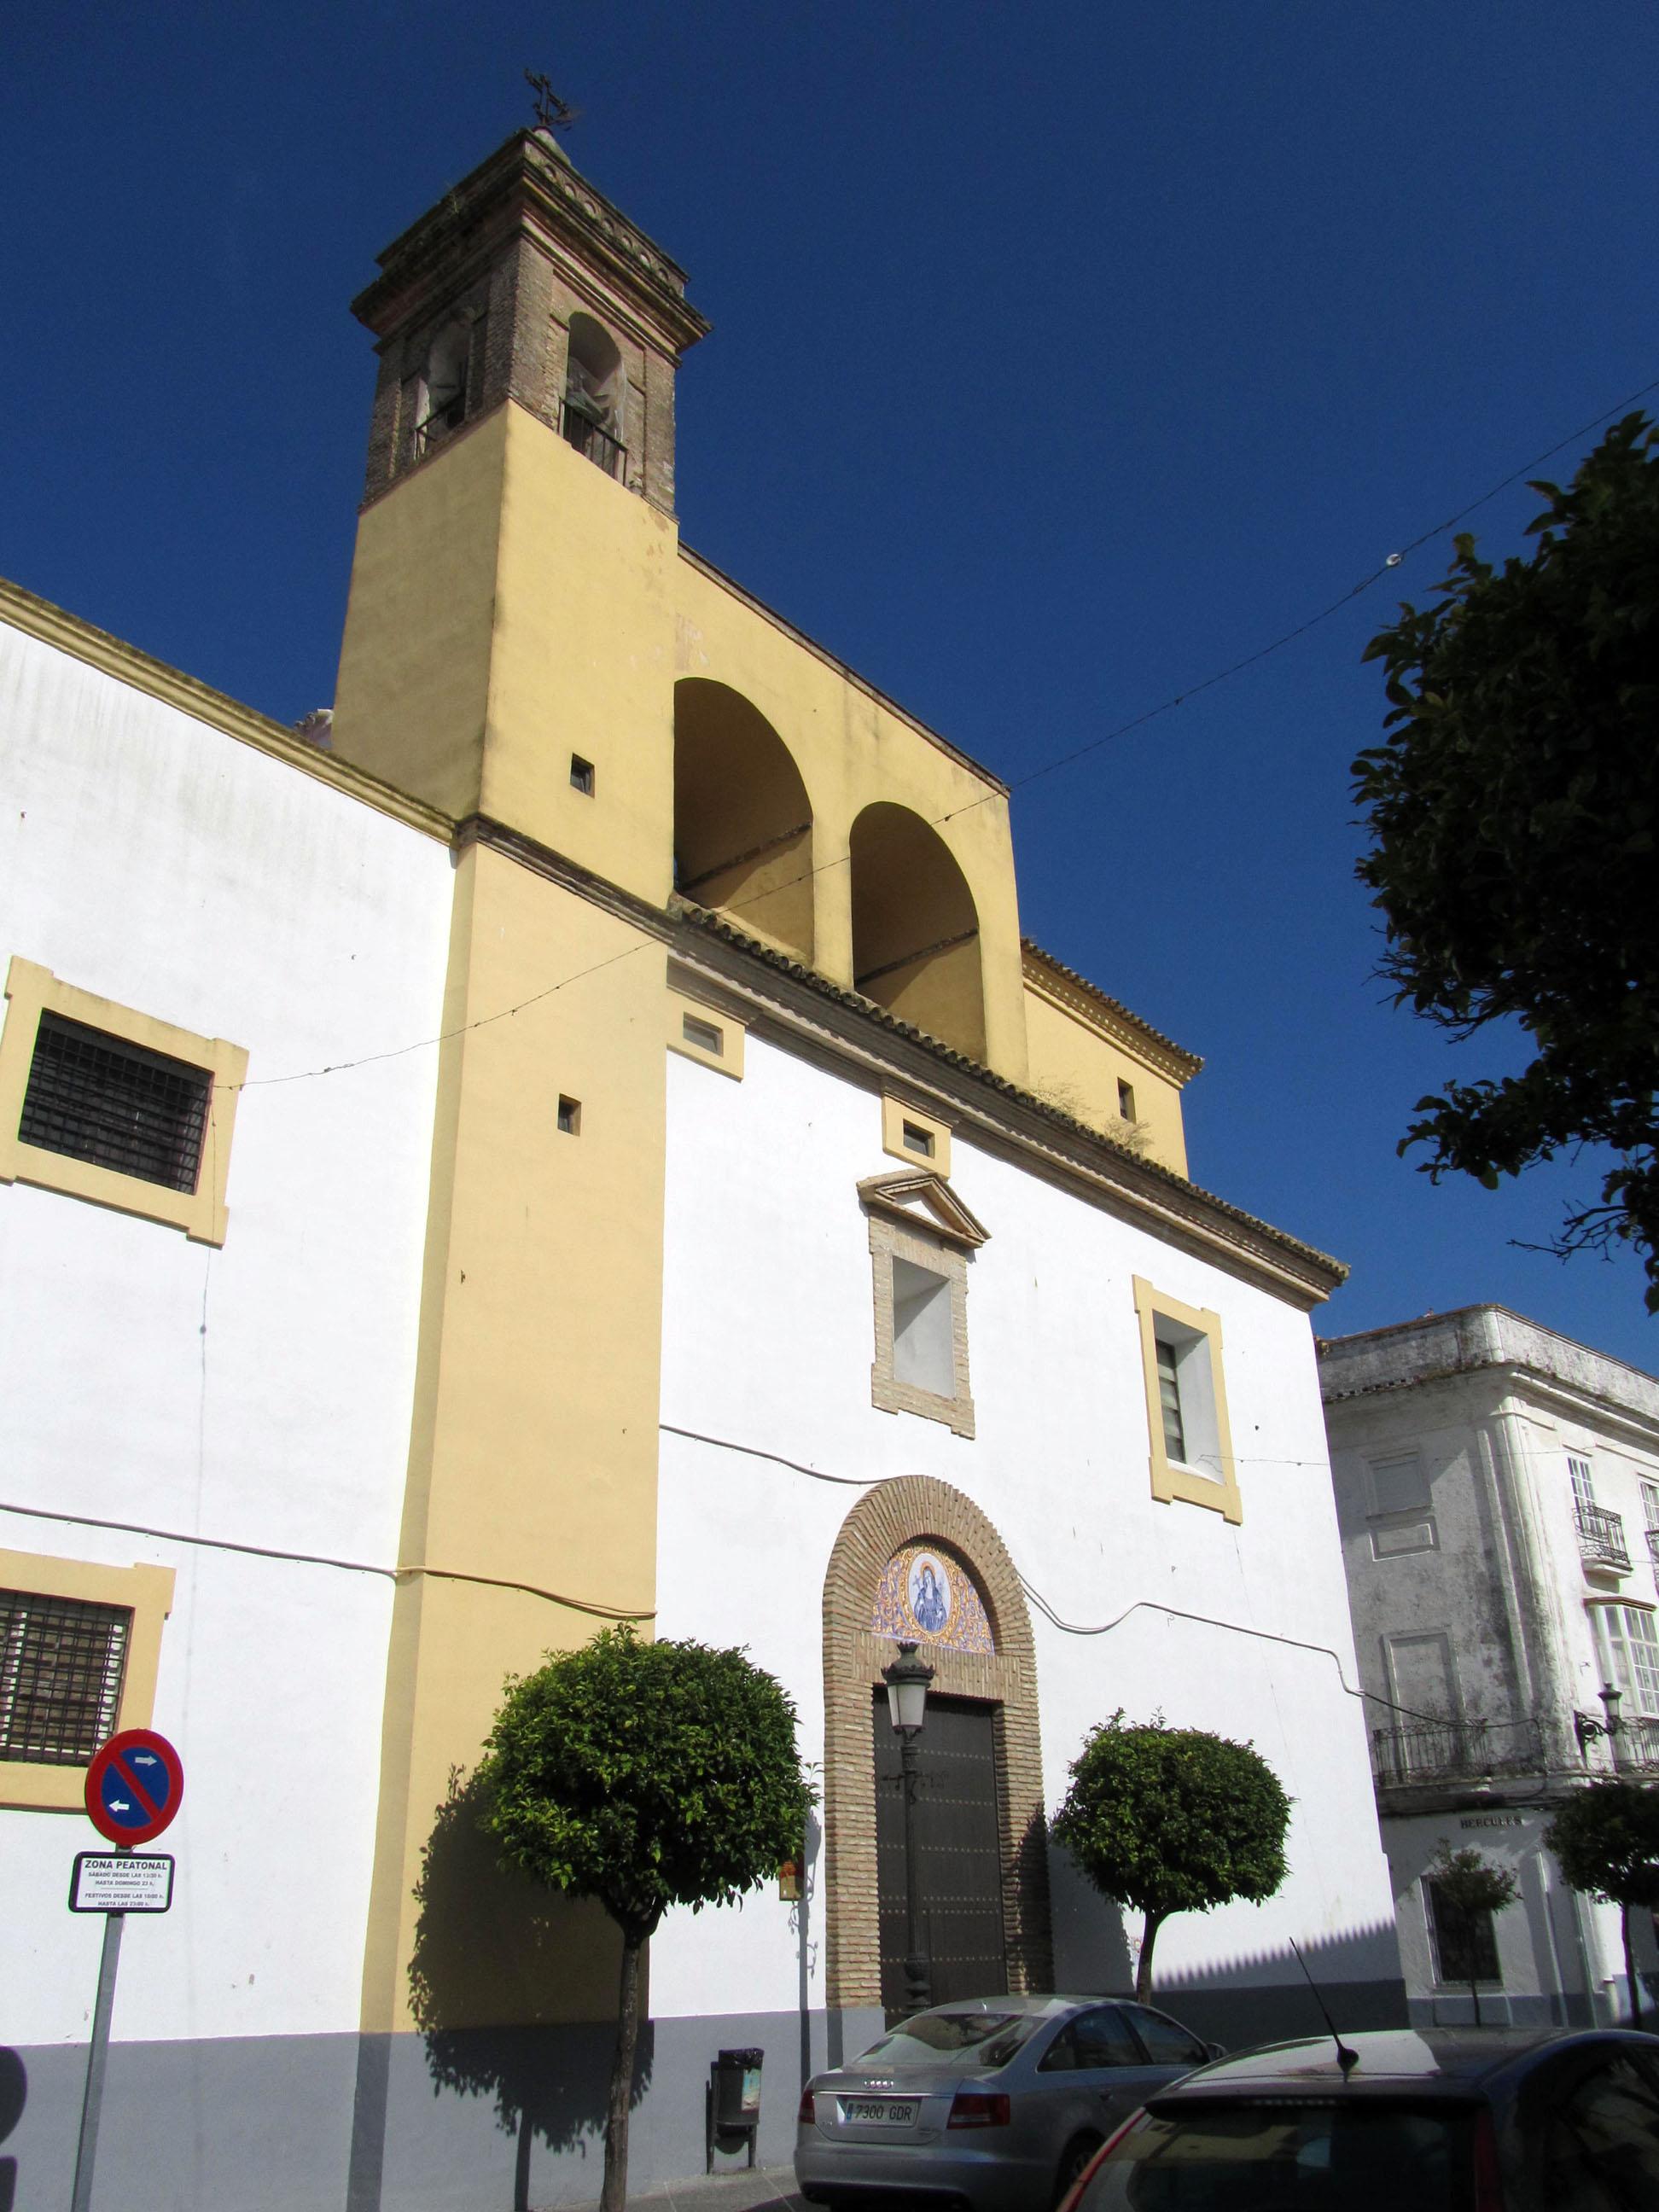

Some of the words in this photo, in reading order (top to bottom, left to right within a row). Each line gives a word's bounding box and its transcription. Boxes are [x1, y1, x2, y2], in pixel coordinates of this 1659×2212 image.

[1460, 1815, 1522, 1829] HERCULES
[84, 1860, 113, 1869] ZONA
[116, 1860, 167, 1871] PEATONAL
[854, 2104, 884, 2120] 7300
[889, 2105, 912, 2121] GDR
